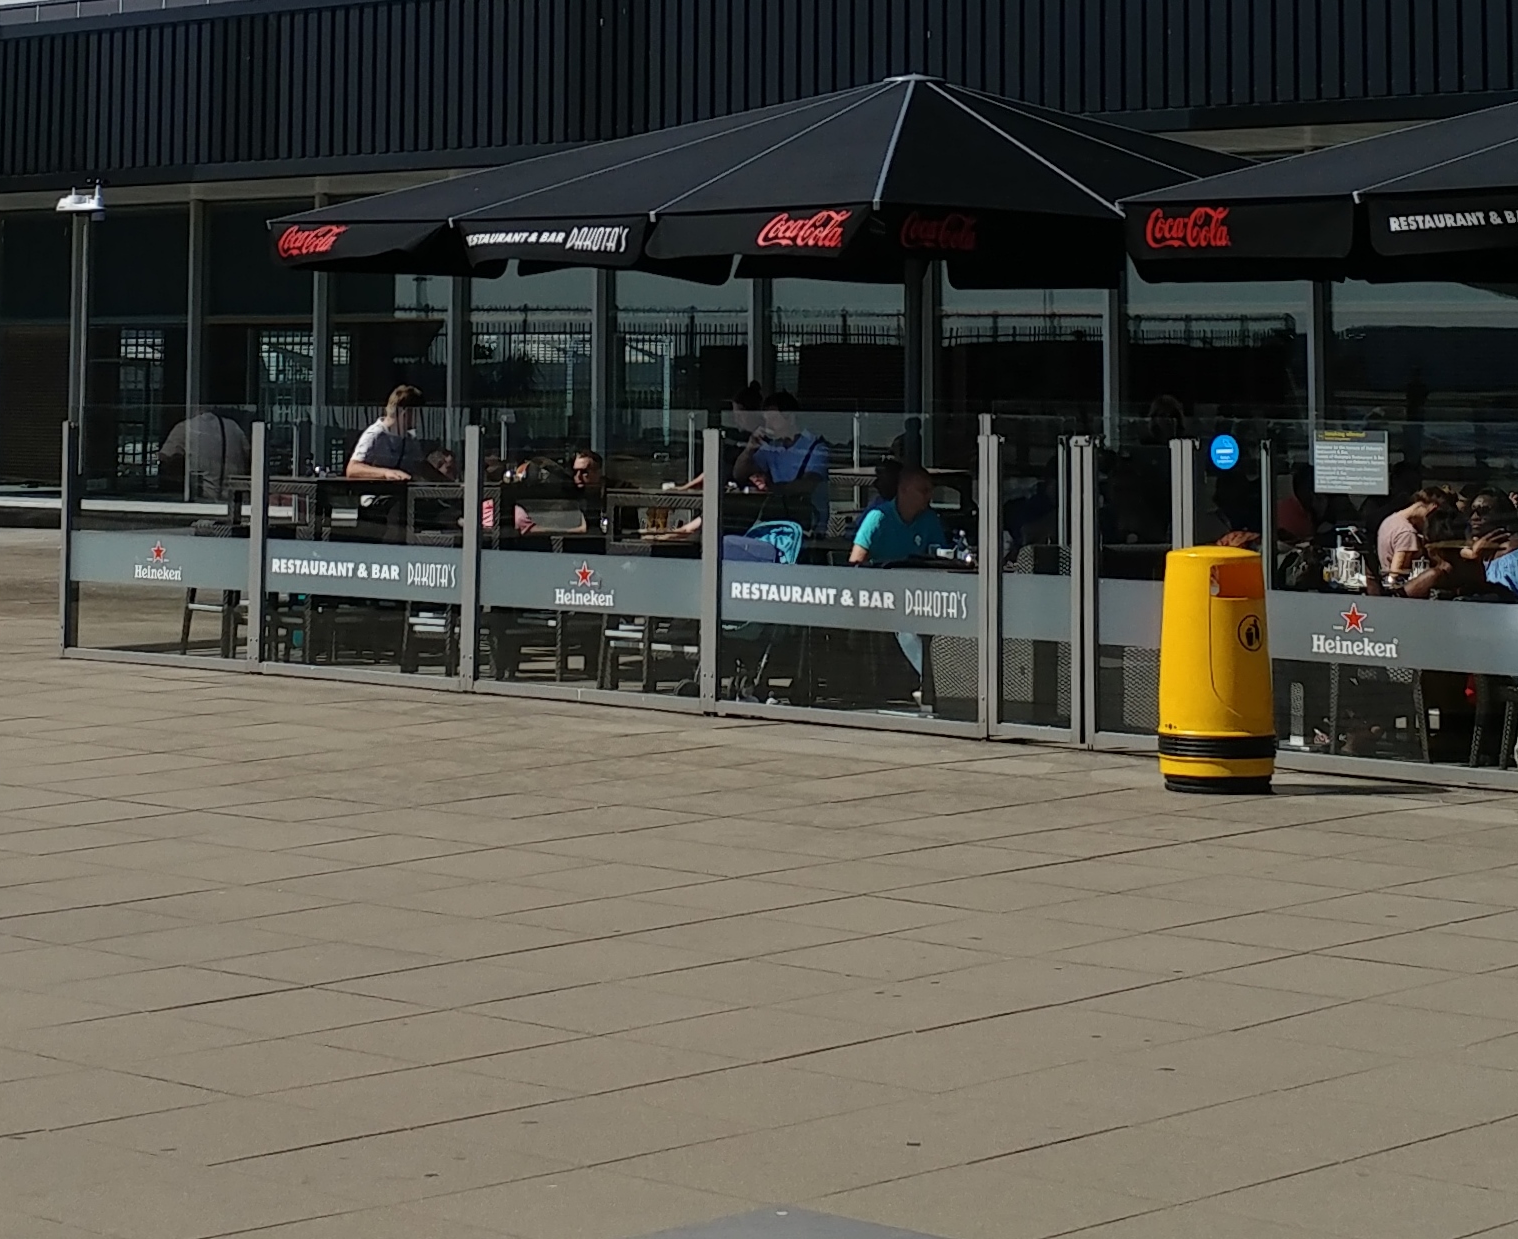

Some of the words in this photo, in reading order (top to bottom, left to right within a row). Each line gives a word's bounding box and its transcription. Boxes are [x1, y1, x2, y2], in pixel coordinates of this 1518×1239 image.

[1389, 212, 1485, 231] RESTAURANT
[1489, 210, 1504, 225] &
[539, 232, 566, 243] BAR
[565, 225, 630, 253] DAKOTA'S
[134, 564, 182, 581] Heineken
[272, 558, 354, 578] RESTAURANT
[357, 562, 368, 578] &
[371, 564, 400, 581] BAR
[407, 562, 457, 588] DAKOTA'S
[554, 588, 614, 607] Heineken
[731, 581, 837, 606] RESTAURANT
[840, 588, 855, 606] &
[859, 589, 896, 610] BAR
[904, 588, 968, 619] DAKOTA'S
[1312, 634, 1398, 658] Heineken
